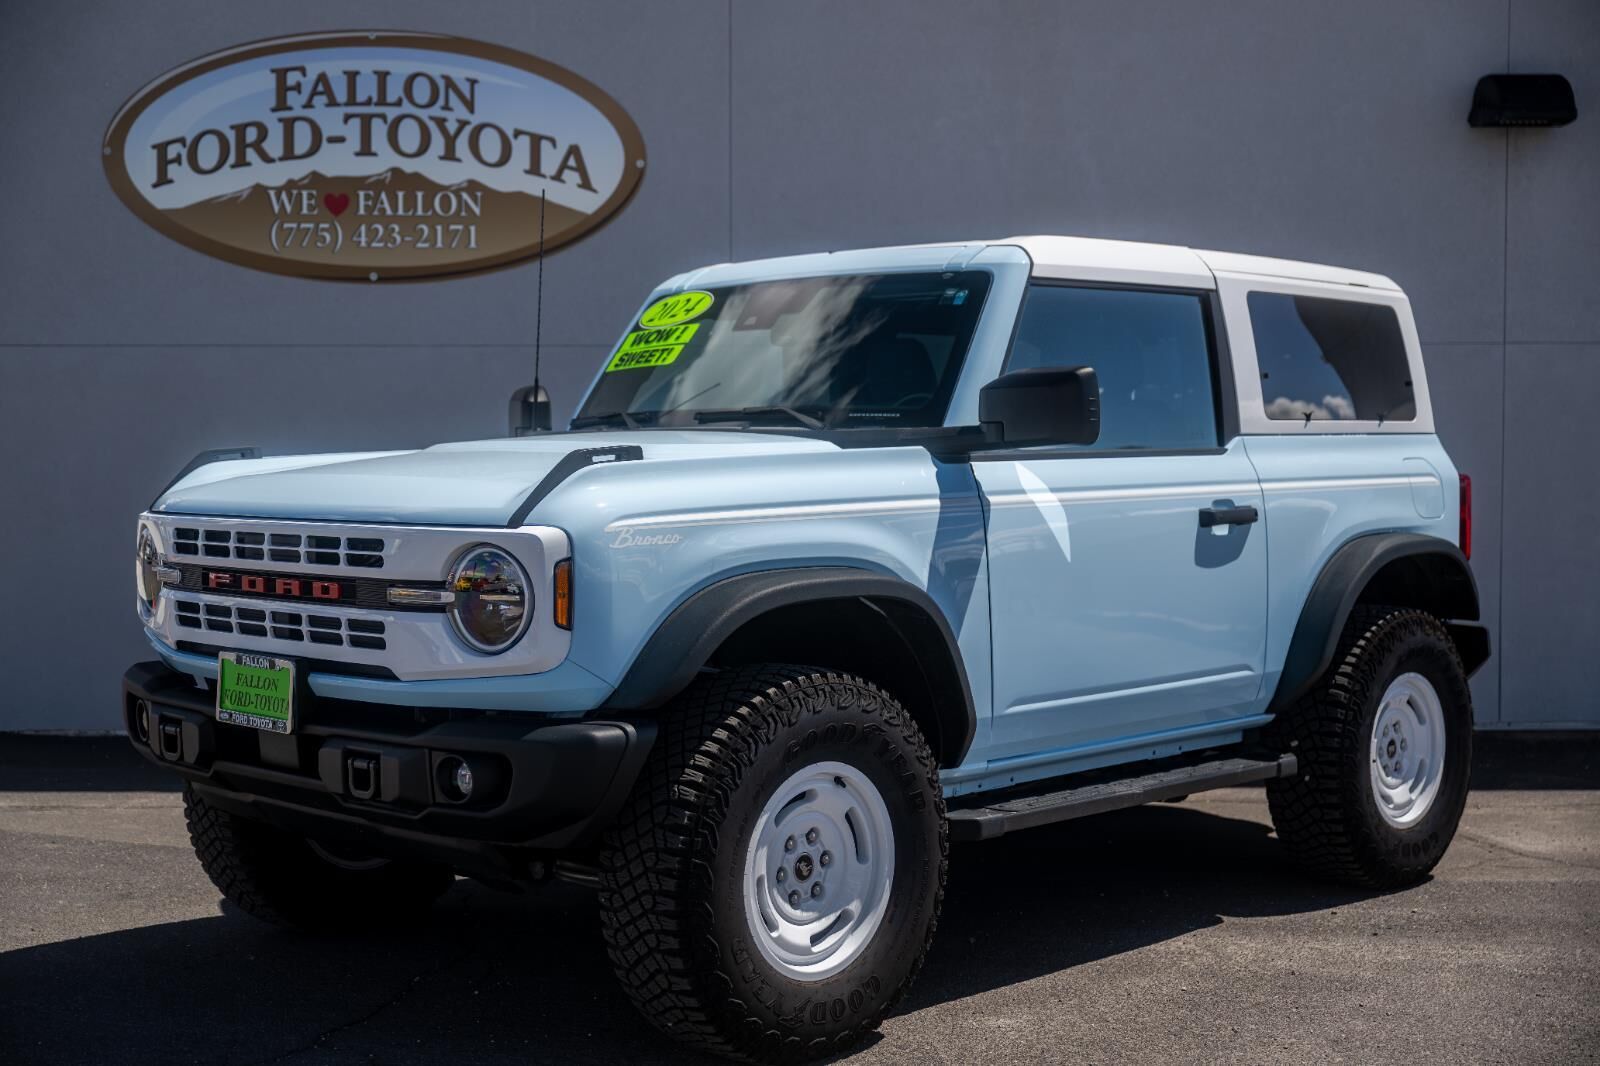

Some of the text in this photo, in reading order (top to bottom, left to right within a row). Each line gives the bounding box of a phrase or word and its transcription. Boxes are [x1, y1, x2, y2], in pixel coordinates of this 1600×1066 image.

[270, 65, 478, 115] FALLON
[151, 112, 599, 194] FORD-TOYOTA
[268, 189, 483, 216] WE FALLON
[269, 220, 478, 254] (775) 423-2171
[614, 347, 675, 368] SWEET!
[608, 526, 682, 549] Bronco
[208, 571, 342, 599] FORD
[242, 655, 270, 670] FALLON
[235, 672, 280, 693] FALLON
[231, 713, 273, 730] FORD TOYOTA
